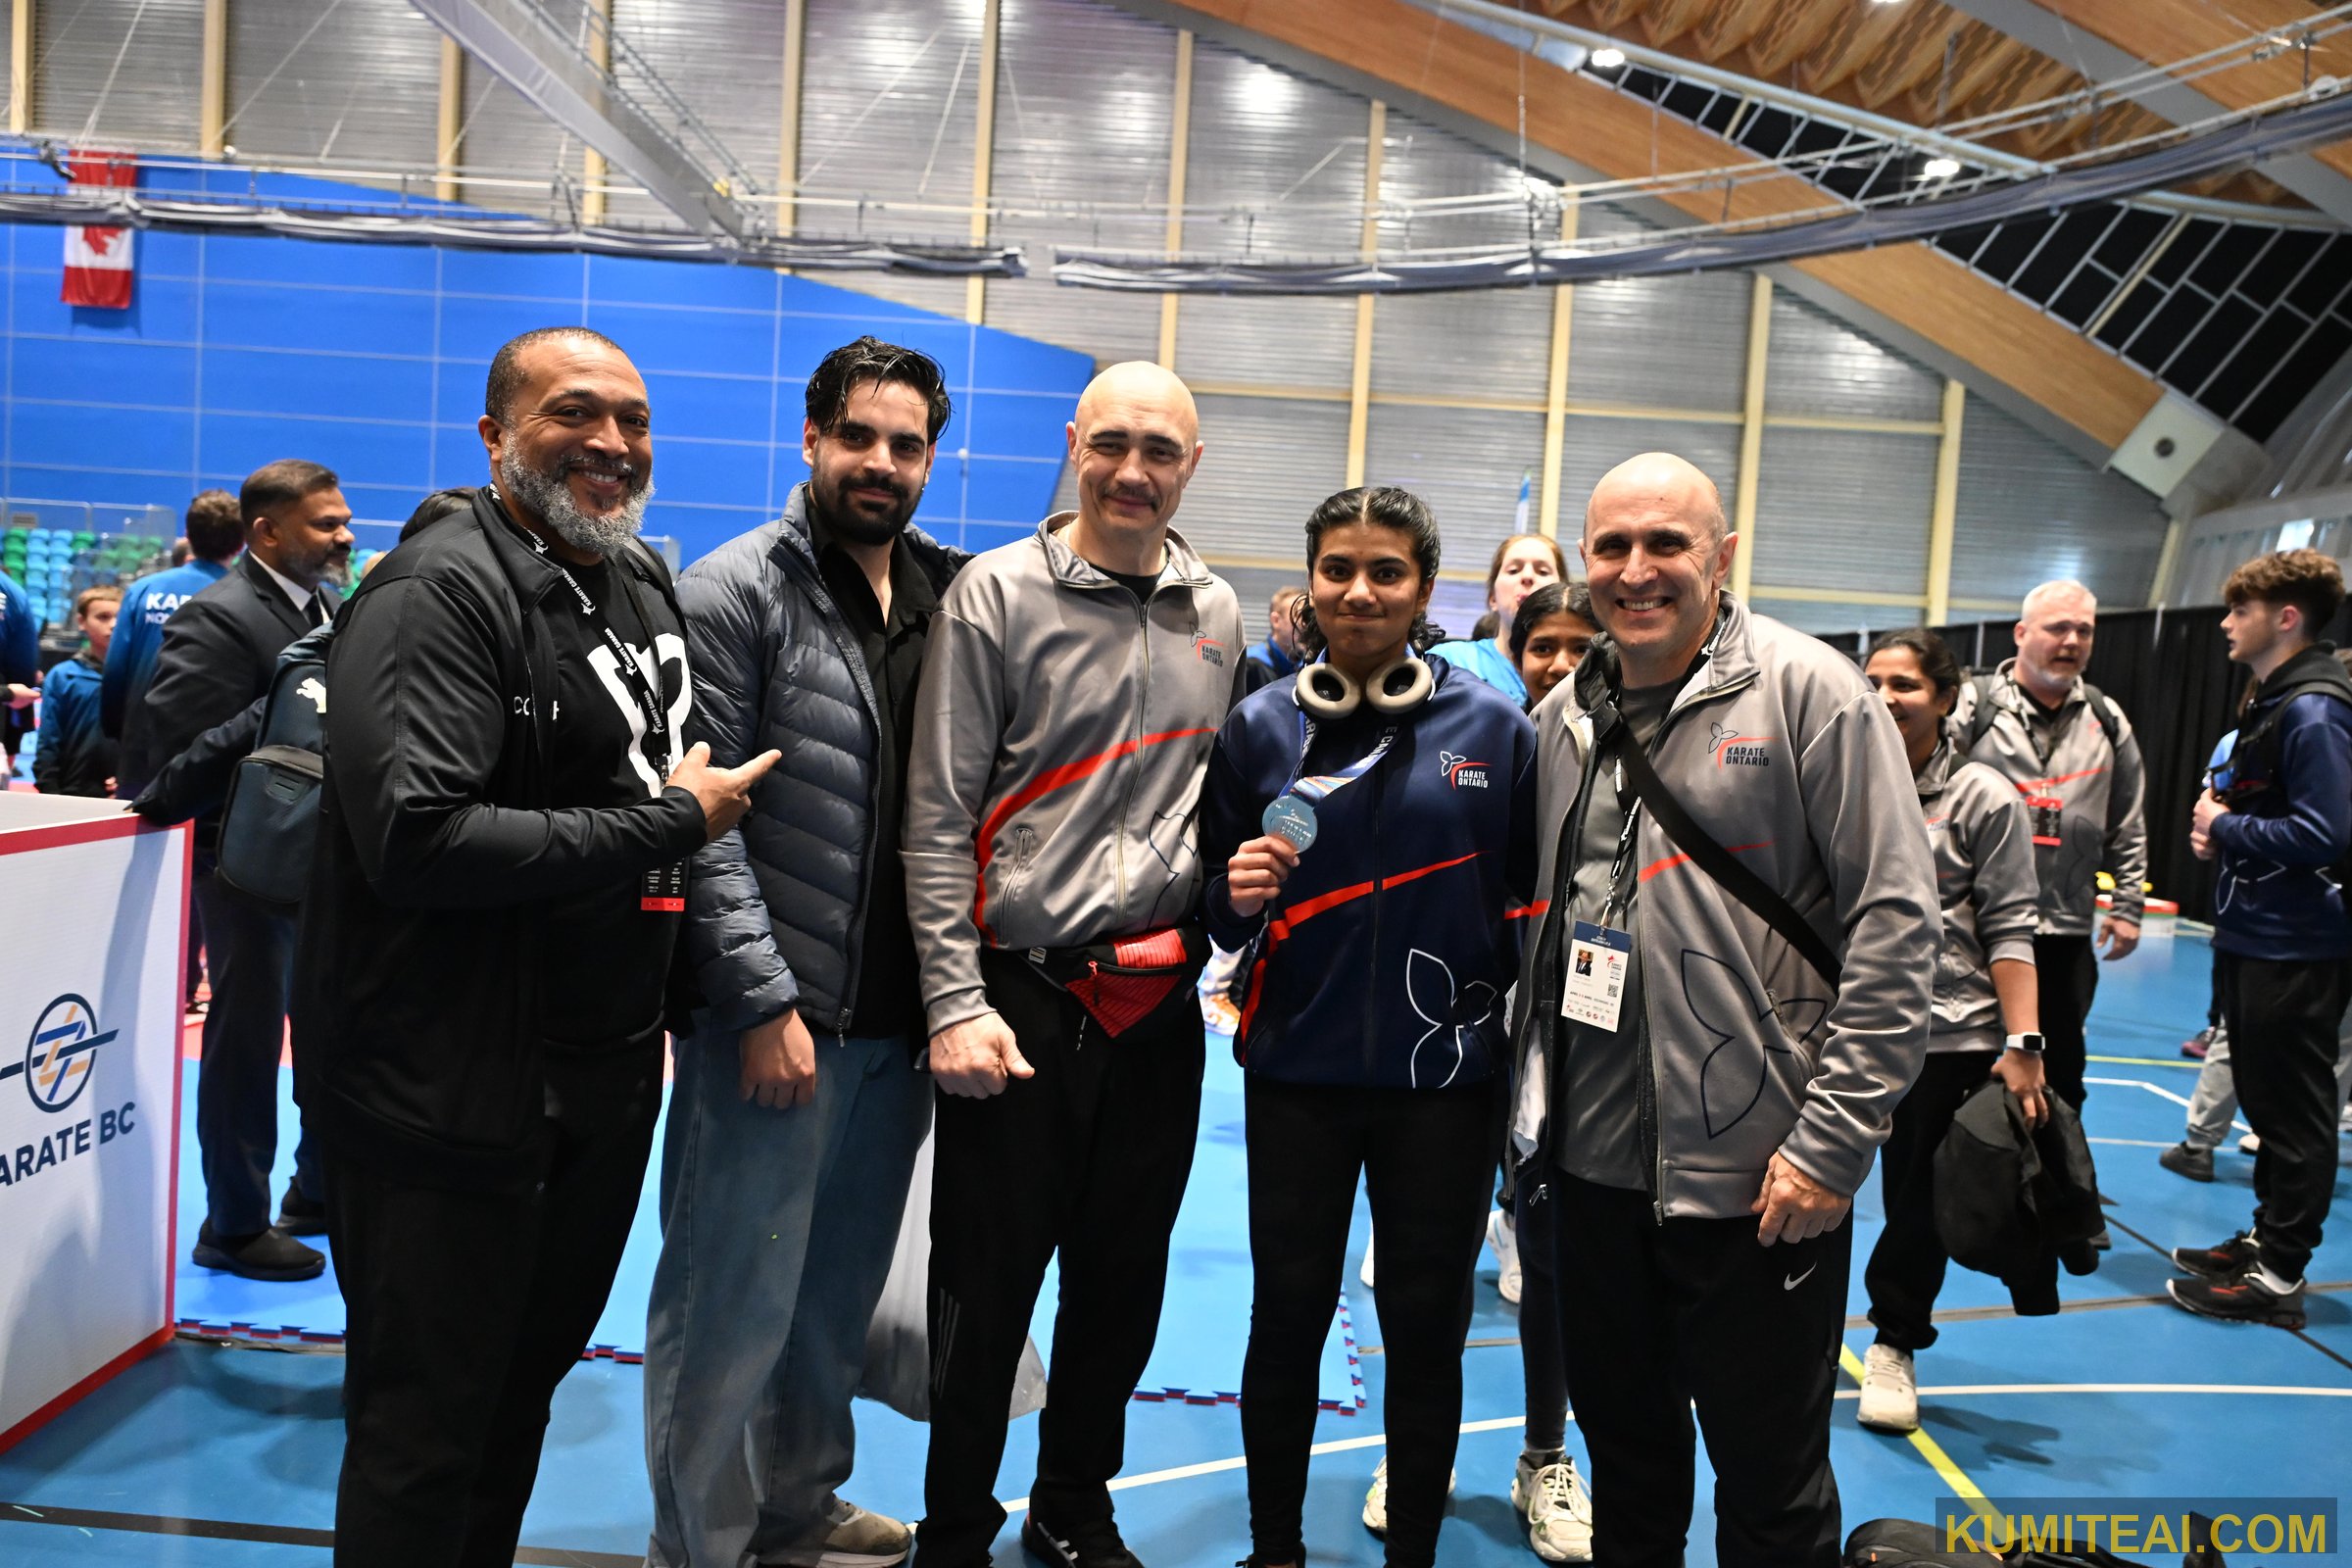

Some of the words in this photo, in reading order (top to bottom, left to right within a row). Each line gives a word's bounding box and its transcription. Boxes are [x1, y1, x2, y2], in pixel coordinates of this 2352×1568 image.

[574, 586, 592, 606] KARATE
[605, 627, 622, 649] CANADA
[617, 648, 634, 667] KARATE
[1202, 645, 1221, 659] KARATE
[643, 690, 655, 709] CANADA
[651, 709, 662, 727] KARATE
[1726, 756, 1770, 766] ONTARIO
[1728, 747, 1765, 757] KARATE
[1458, 769, 1486, 780] KARATE
[1458, 777, 1489, 788] ONTARIO
[99, 1102, 135, 1145] BC
